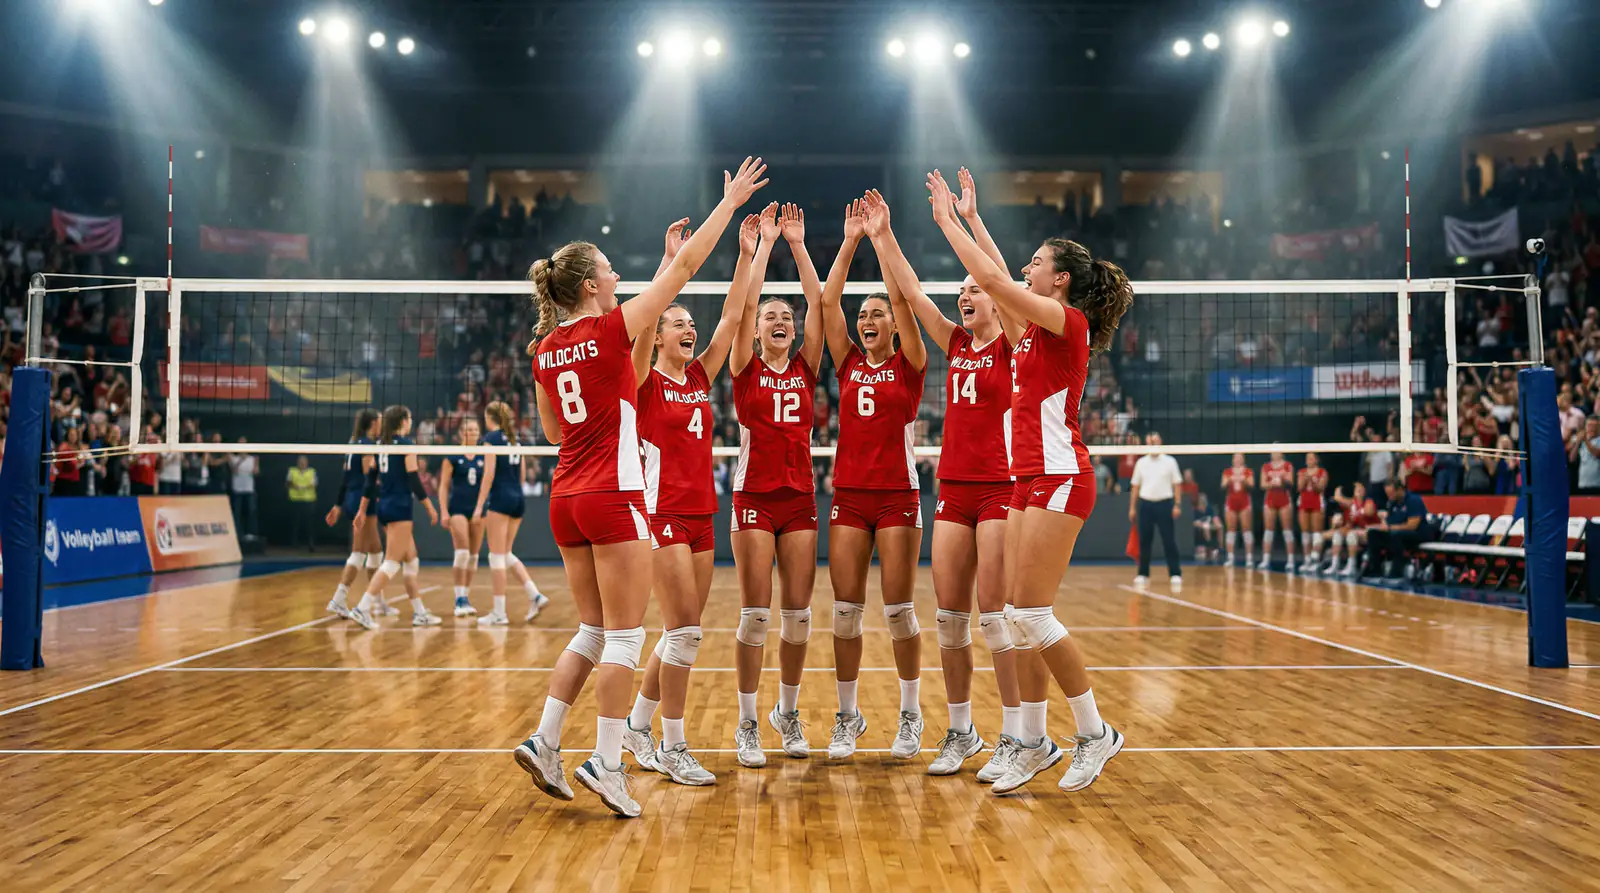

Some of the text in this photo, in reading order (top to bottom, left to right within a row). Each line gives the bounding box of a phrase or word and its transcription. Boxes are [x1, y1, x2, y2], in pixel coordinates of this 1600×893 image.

[538, 340, 598, 370] WILDCATS
[949, 355, 993, 370] WILDCATS
[850, 369, 895, 384] WILDCATS
[952, 372, 977, 405] 14
[557, 370, 587, 424] 8
[773, 392, 801, 423] 12
[858, 385, 875, 417] 6
[687, 407, 703, 440] 4
[742, 508, 757, 524] 12
[831, 505, 839, 520] 6
[60, 527, 115, 551] Volleyball
[662, 523, 673, 539] 4
